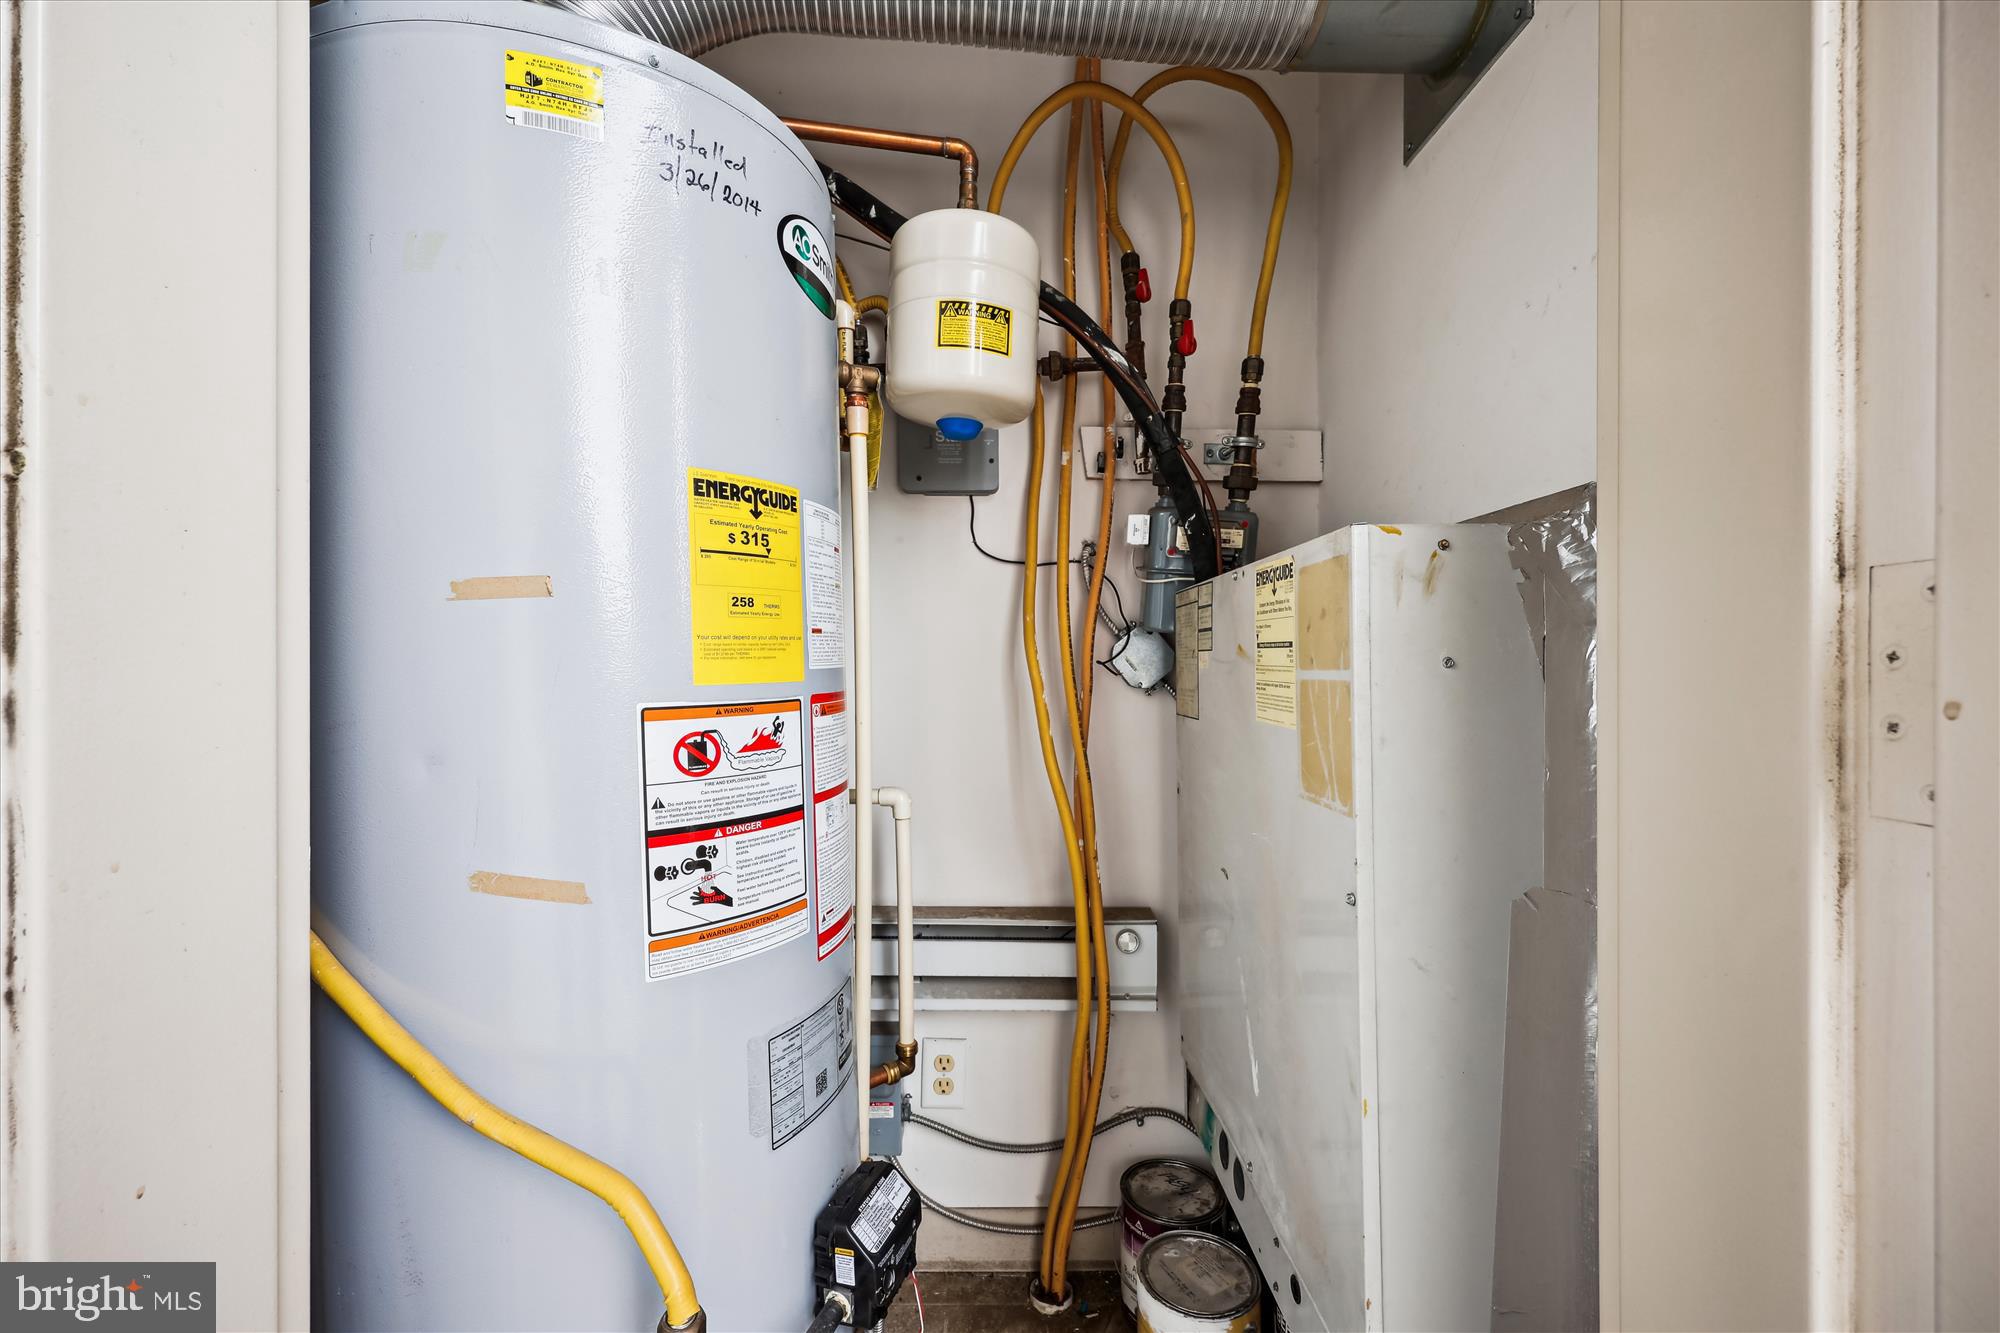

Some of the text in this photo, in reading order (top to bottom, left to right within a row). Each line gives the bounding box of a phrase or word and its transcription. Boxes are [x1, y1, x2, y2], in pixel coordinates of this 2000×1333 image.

[546, 76, 584, 89] CONTRACTOR
[640, 123, 748, 179] Installed
[659, 155, 762, 217] 3/26/2014
[958, 308, 992, 318] WANING
[692, 478, 798, 513] ENERGYGUIDE
[710, 518, 738, 528] Estimated
[756, 525, 778, 534] Operating
[728, 530, 770, 548] $ 315
[1256, 562, 1294, 587] ENERGYGUIDE
[731, 596, 754, 608] 258
[724, 706, 754, 714] WARNING
[738, 756, 764, 766] Flammable
[726, 776, 750, 784] EXPLOSION
[726, 821, 762, 835] DANGER
[703, 894, 726, 904] BURN
[705, 912, 780, 939] WARNING/ADVERTENCIA
[858, 1176, 886, 1213] STATUS LIGHT CODE
[901, 1196, 912, 1210] OUTLET
